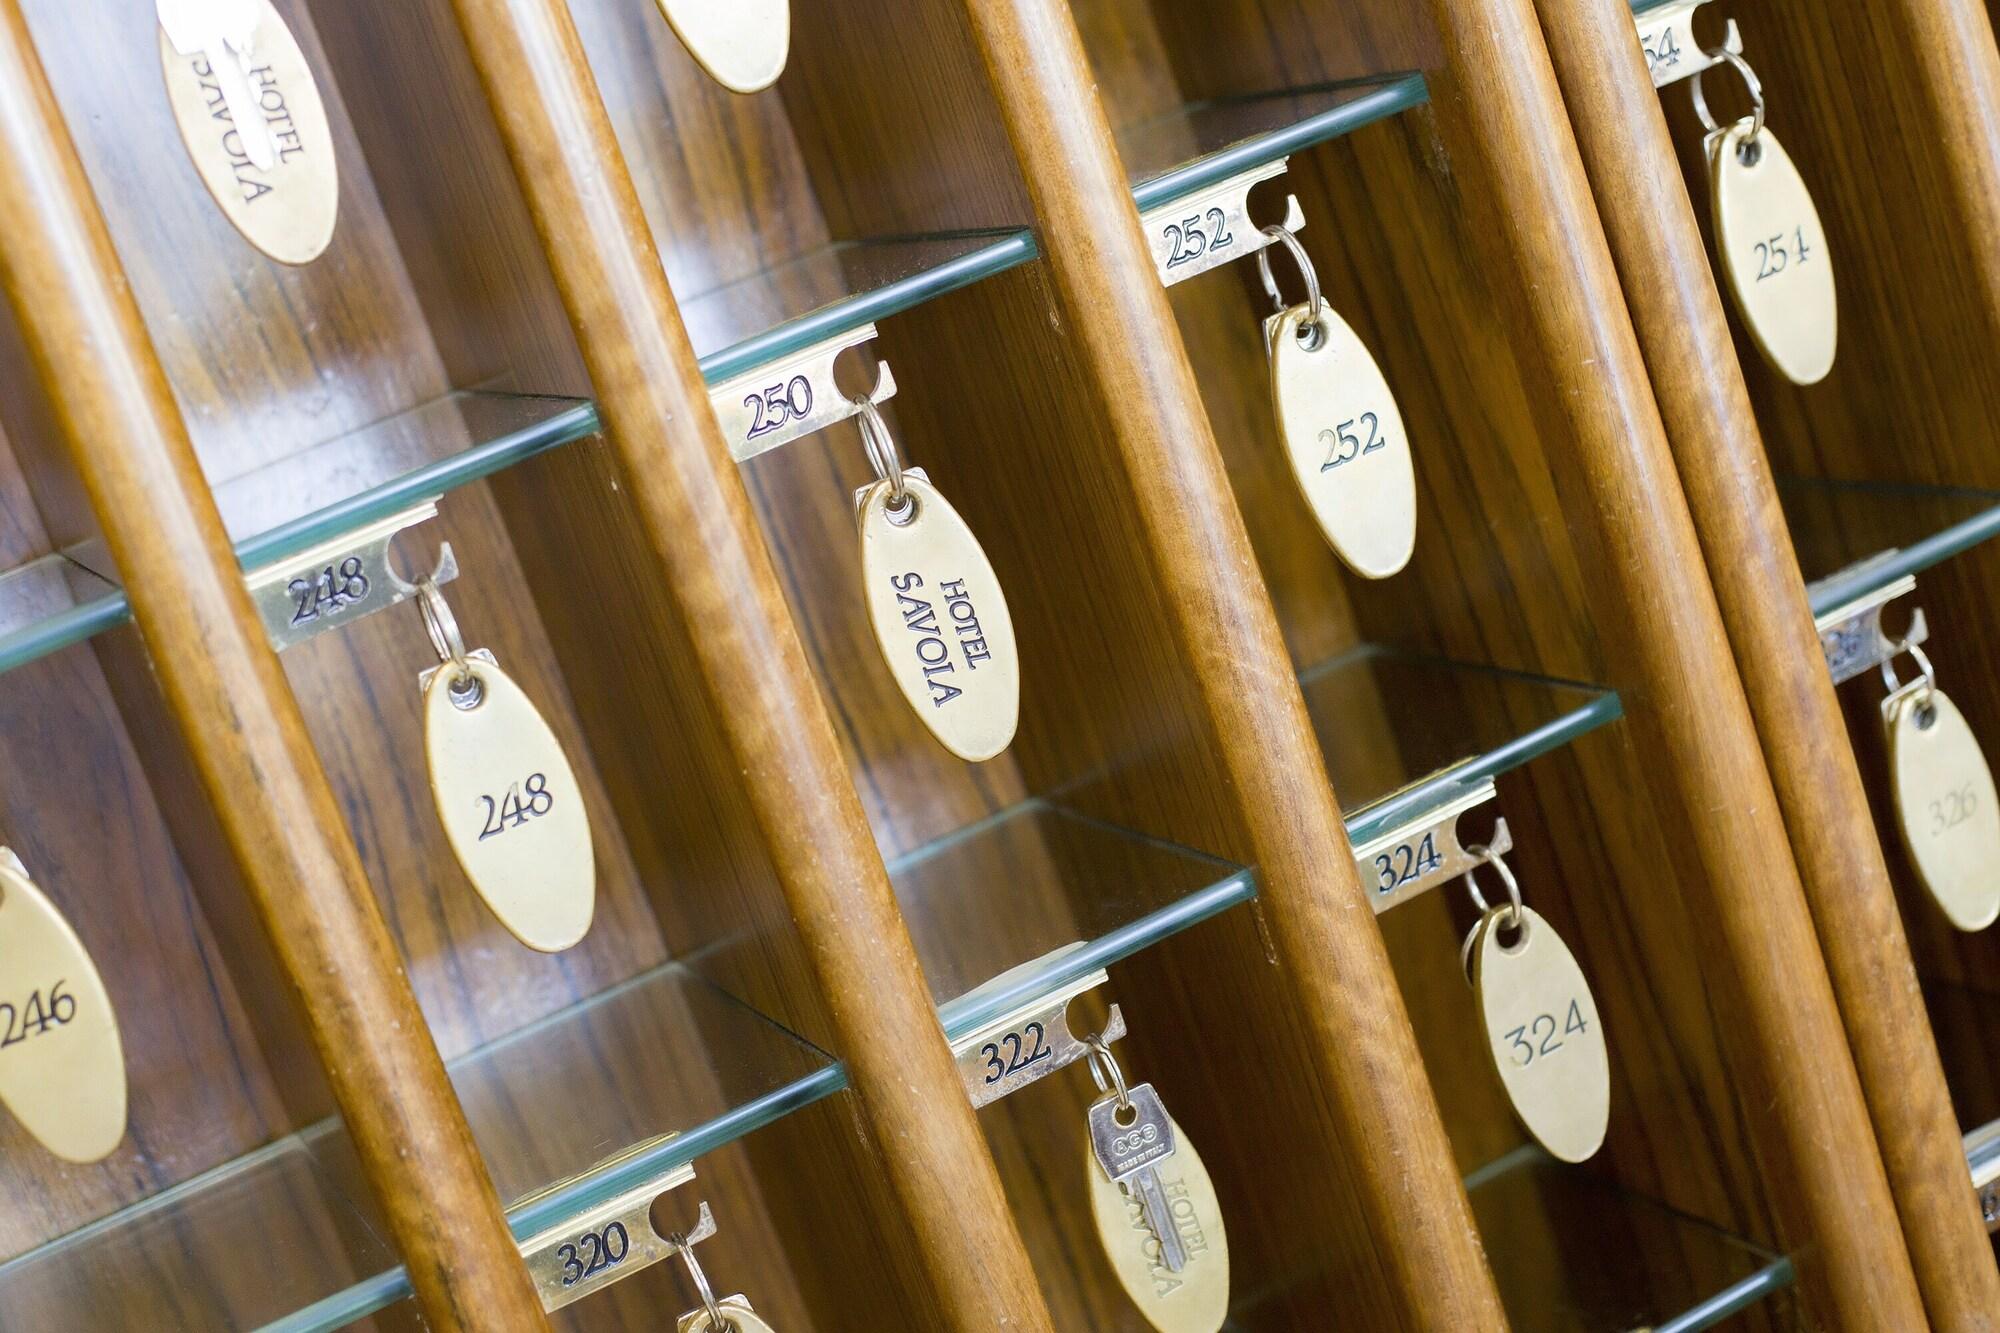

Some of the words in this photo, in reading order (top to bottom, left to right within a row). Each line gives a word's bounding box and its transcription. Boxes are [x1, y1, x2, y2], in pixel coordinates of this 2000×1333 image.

[250, 65, 304, 164] HOTEL
[1163, 207, 1233, 269] 252
[1754, 225, 1810, 281] 254
[743, 375, 813, 440] 250
[1318, 412, 1385, 473] 252
[288, 556, 371, 629] 248
[940, 578, 992, 670] HOTEL
[891, 572, 962, 708] SAVOIA
[475, 773, 553, 841] 248
[1928, 779, 1978, 837] 326
[1375, 832, 1442, 894] 324
[0, 979, 75, 1048] 246
[1504, 998, 1588, 1066] 324
[982, 1022, 1051, 1085] 322
[1164, 1177, 1209, 1261] HOTEL
[557, 1221, 630, 1288] 320
